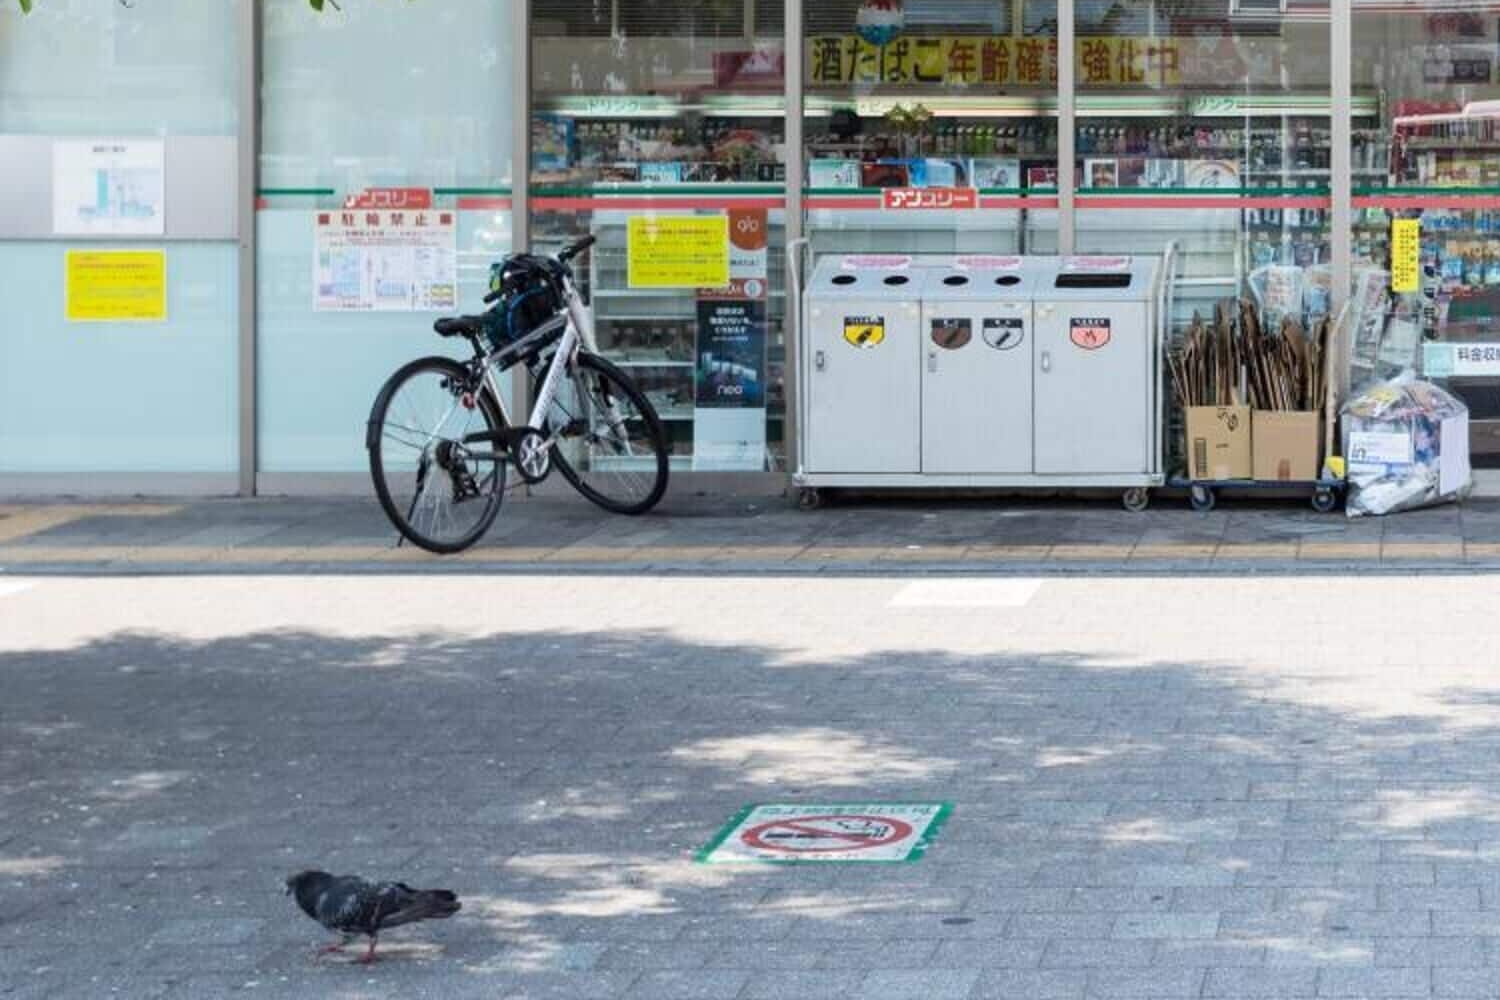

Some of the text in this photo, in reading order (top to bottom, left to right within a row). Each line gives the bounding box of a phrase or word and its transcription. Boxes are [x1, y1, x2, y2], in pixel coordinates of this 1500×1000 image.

[890, 191, 969, 208] アンスリー
